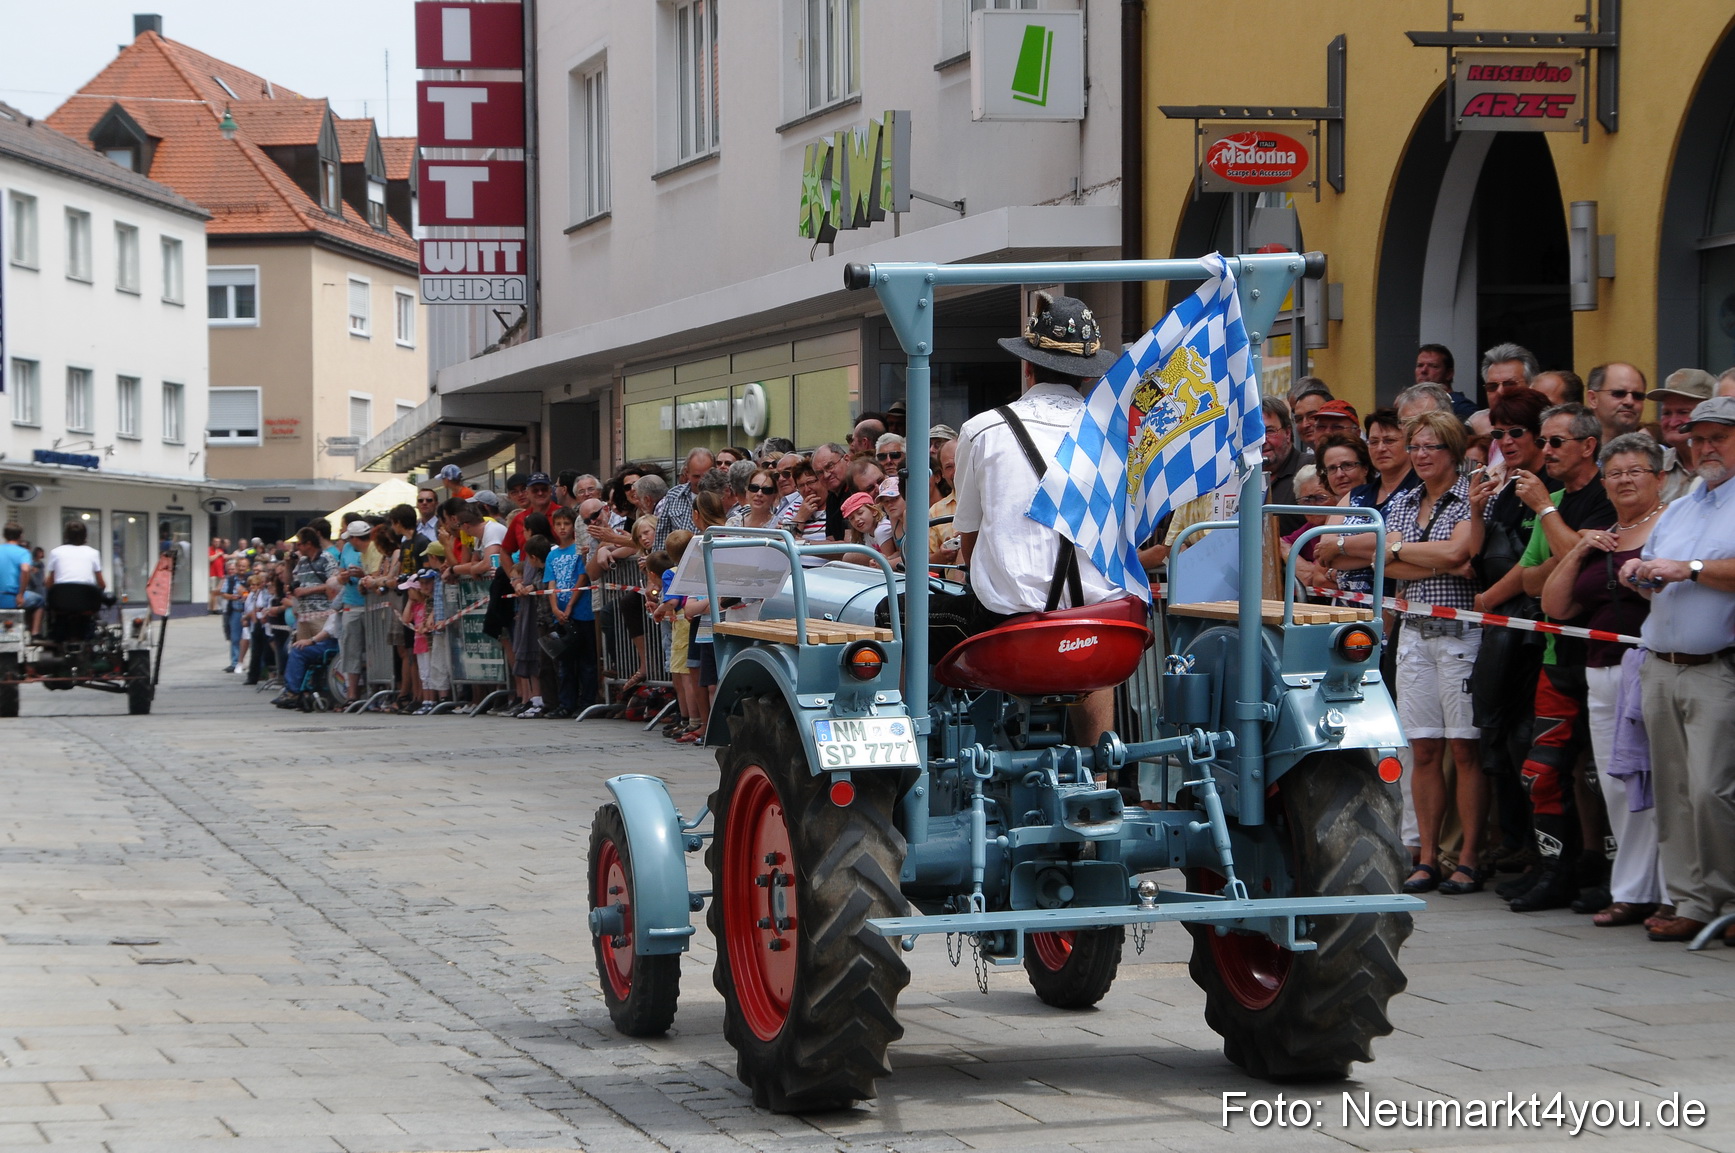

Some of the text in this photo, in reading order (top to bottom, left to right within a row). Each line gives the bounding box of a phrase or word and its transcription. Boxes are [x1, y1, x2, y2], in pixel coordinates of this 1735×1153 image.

[1467, 61, 1572, 82] REISEBÜRO
[1461, 93, 1576, 118] ARZT
[1221, 146, 1296, 164] Madonna
[799, 110, 904, 242] KIWI
[1227, 169, 1249, 178] Scarpe
[1259, 169, 1292, 177] Accessori
[424, 242, 521, 272] WITT
[423, 278, 524, 300] WEIDEN
[1058, 636, 1098, 652] Eicher
[833, 721, 867, 742] NM
[826, 742, 909, 765] SP 777
